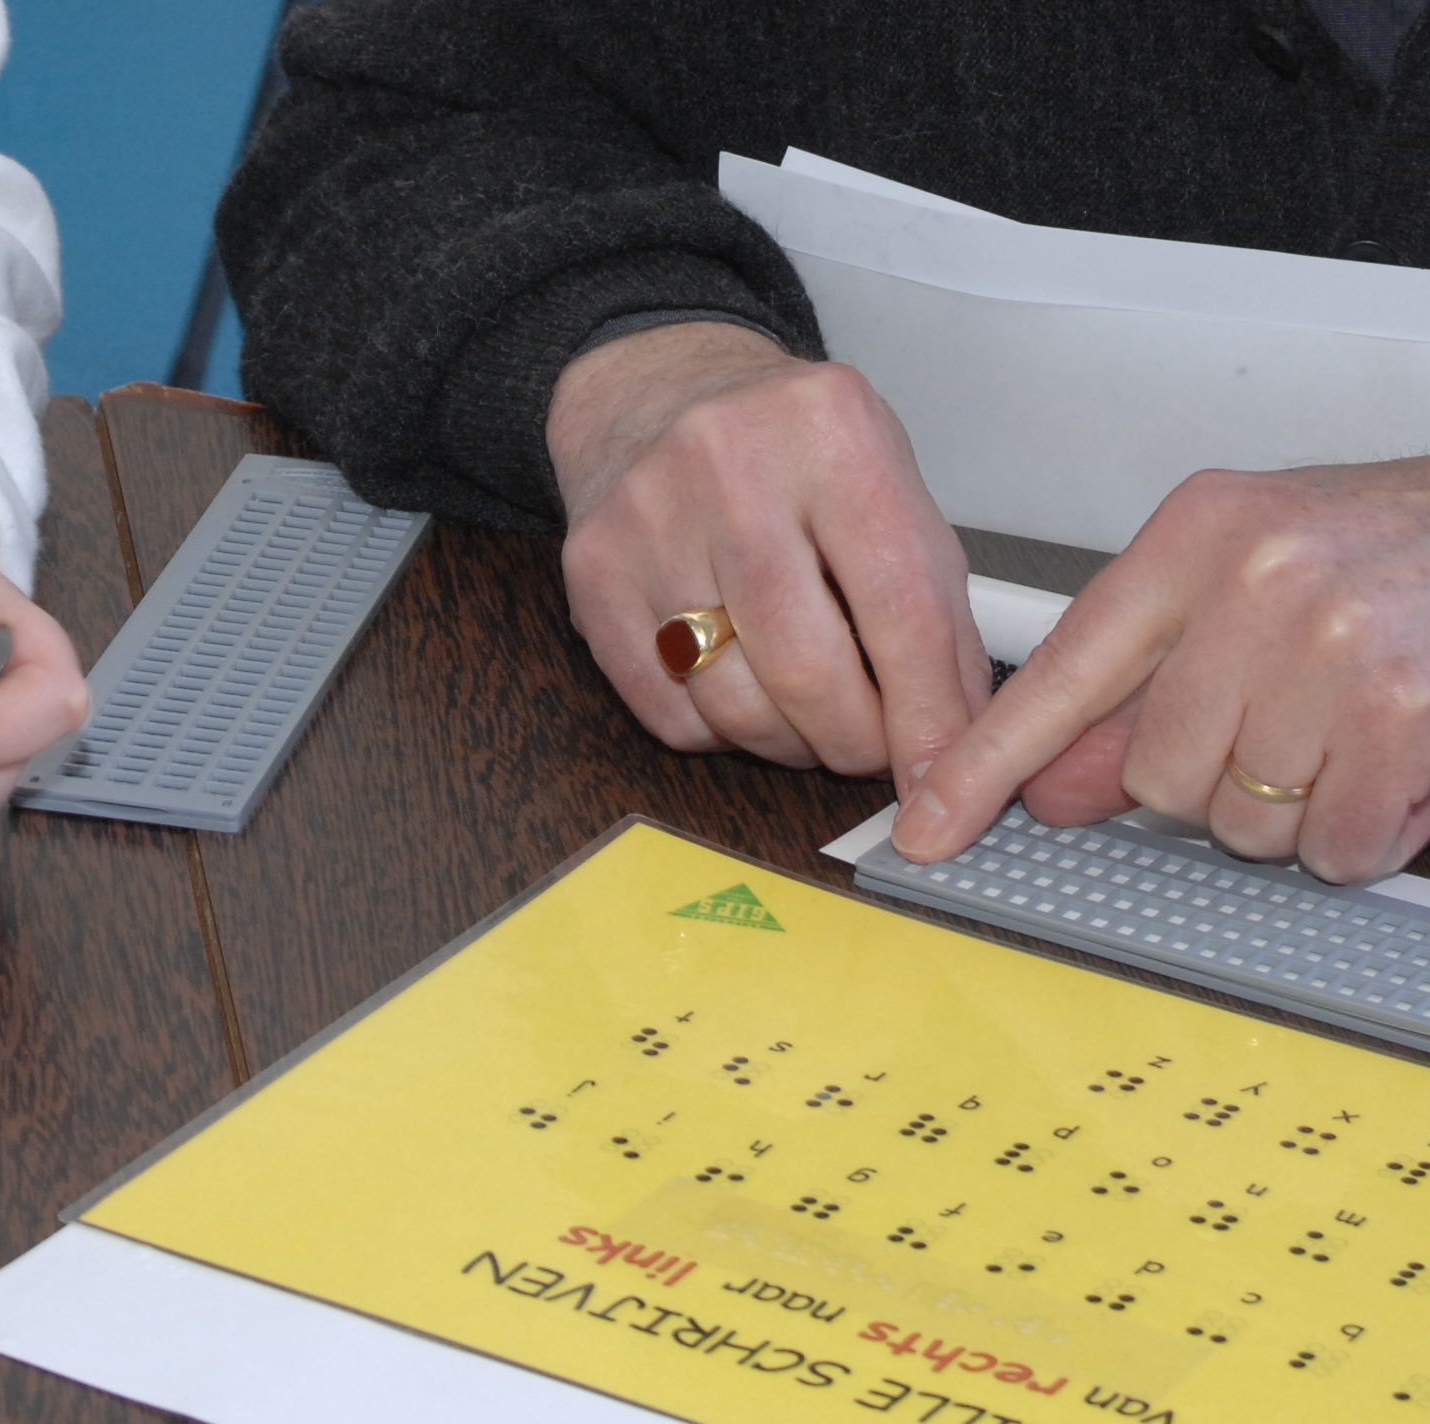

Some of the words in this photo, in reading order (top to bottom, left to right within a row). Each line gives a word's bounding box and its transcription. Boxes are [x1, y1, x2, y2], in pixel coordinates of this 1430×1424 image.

[697, 899, 765, 922] GIPS
[676, 1012, 694, 1023] t
[769, 1042, 793, 1052] s
[1147, 1056, 1171, 1069] z
[864, 1072, 886, 1082] r
[568, 1080, 596, 1096] j
[958, 1095, 981, 1110] q
[658, 1112, 675, 1124] i
[1333, 1110, 1359, 1123] x
[1053, 1126, 1080, 1140] p
[749, 1140, 773, 1158] h
[1152, 1157, 1173, 1167] o
[847, 1168, 877, 1183] g
[1246, 1184, 1267, 1197] n
[939, 1203, 966, 1217] f
[1335, 1210, 1366, 1227] m
[1042, 1231, 1064, 1243] e
[558, 1226, 697, 1288] links
[1135, 1261, 1165, 1274] d
[723, 1278, 845, 1323] naar
[1241, 1293, 1262, 1304] c
[461, 1249, 851, 1389] SCHRIJVEN
[1340, 1324, 1365, 1342] b
[859, 1322, 1068, 1396] rechts
